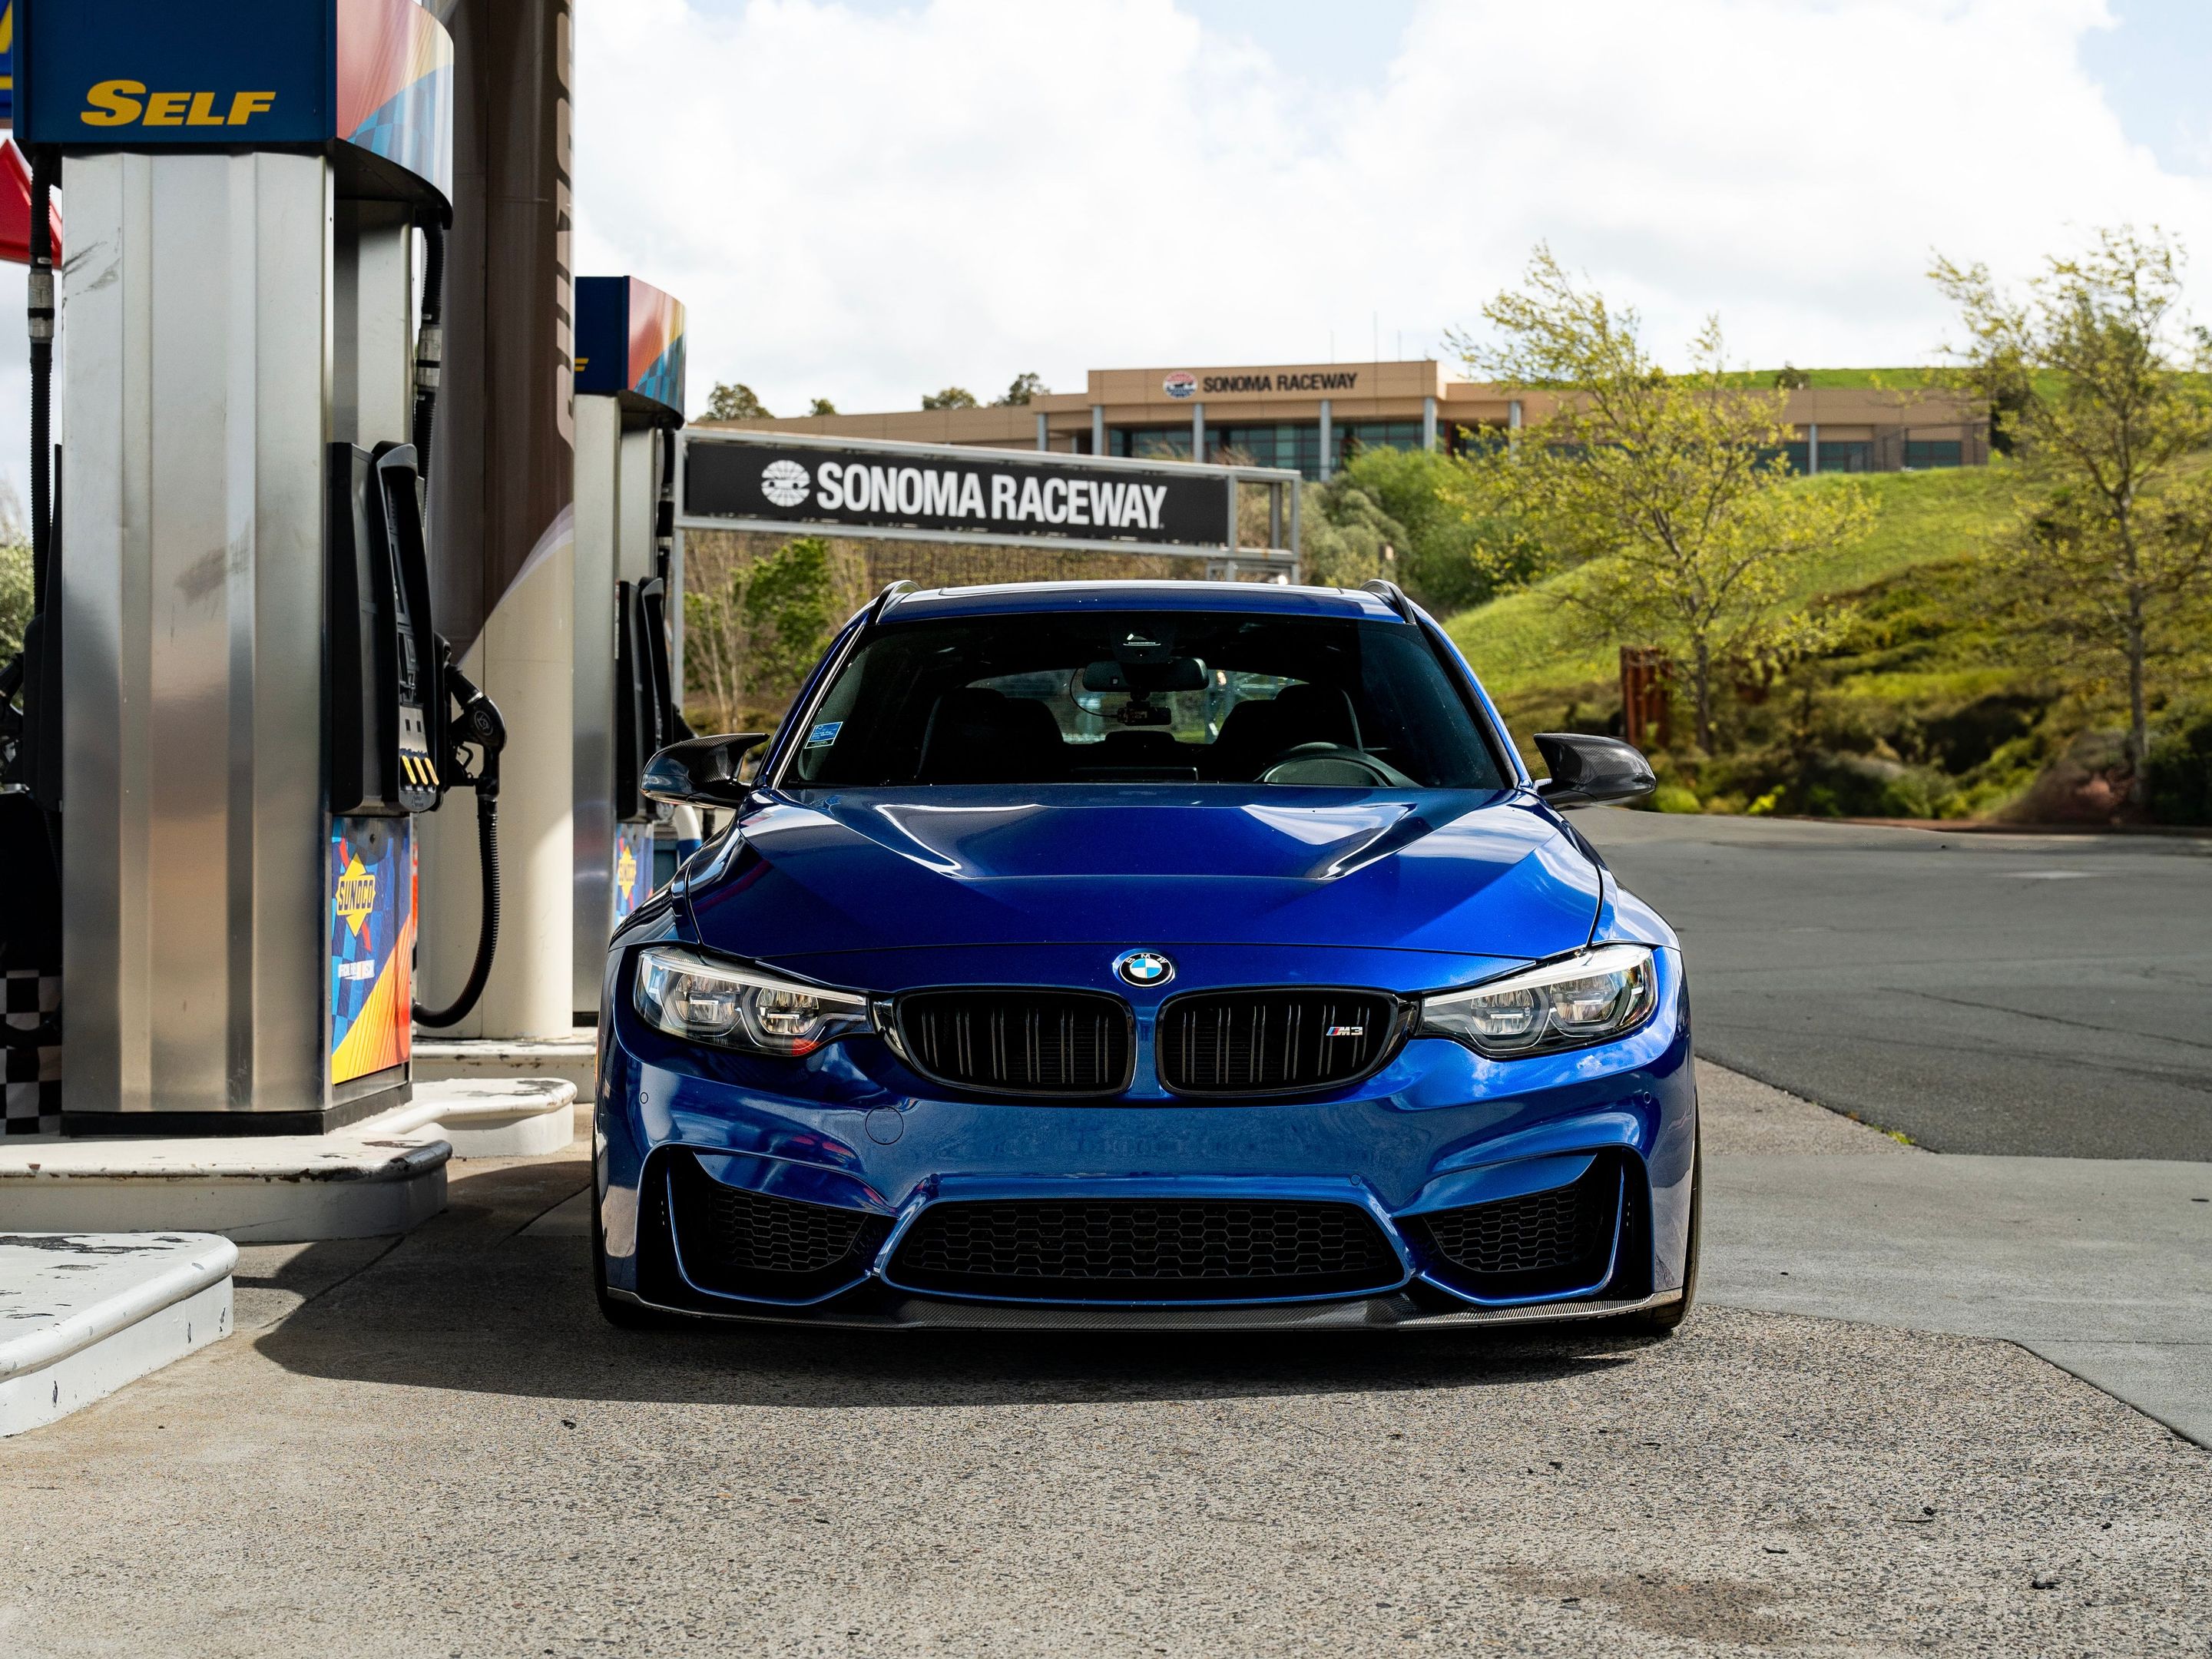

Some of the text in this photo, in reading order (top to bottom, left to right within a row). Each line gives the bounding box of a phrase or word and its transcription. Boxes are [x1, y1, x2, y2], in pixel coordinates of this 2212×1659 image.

[81, 79, 276, 126] SELF
[1203, 373, 1357, 392] SONOMA RACEWAY
[816, 462, 1167, 529] SONOMA RACEWAY
[338, 879, 373, 911] SUNOCO
[1124, 953, 1168, 964] BMW
